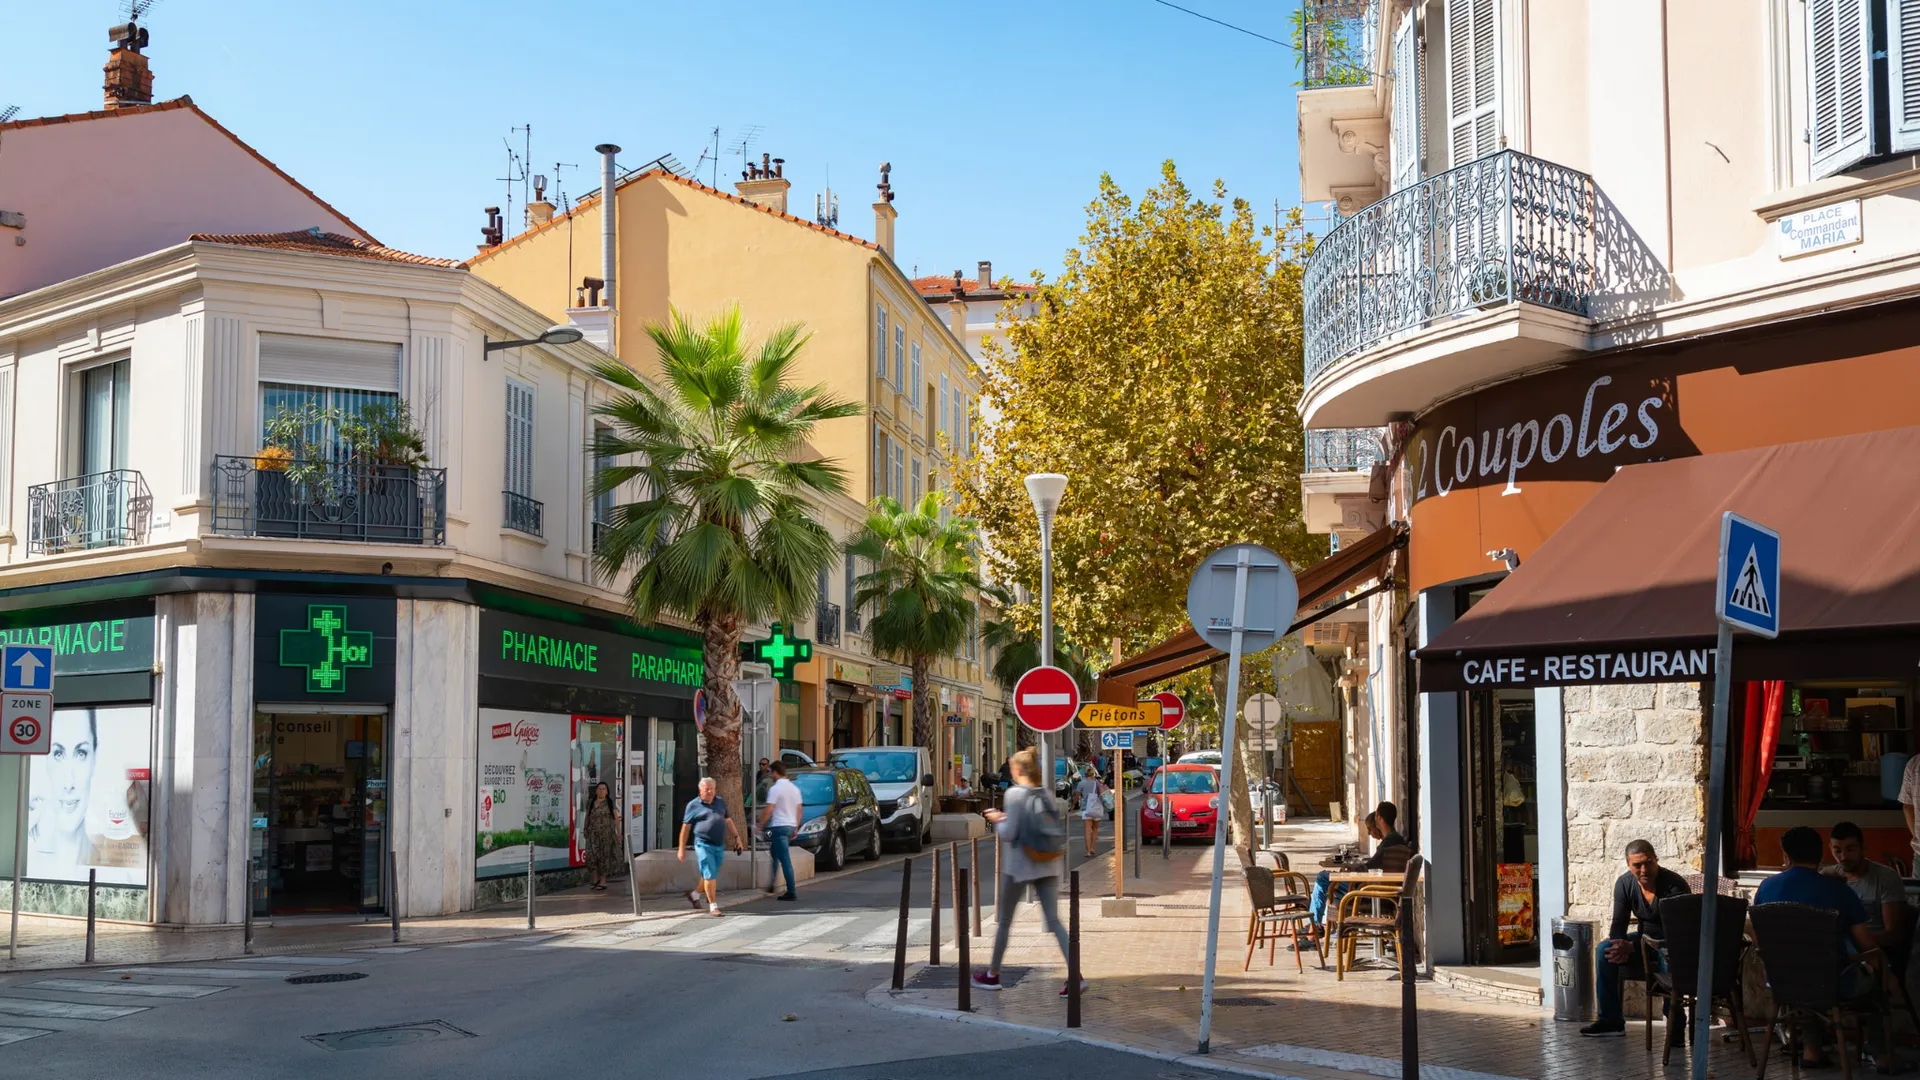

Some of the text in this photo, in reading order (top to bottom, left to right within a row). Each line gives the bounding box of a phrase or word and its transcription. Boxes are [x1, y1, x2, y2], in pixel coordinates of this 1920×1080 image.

[1803, 206, 1842, 224] PLACE
[1790, 216, 1858, 240] Commandant
[1800, 229, 1846, 249] MARIA
[1416, 439, 1428, 500] 2
[1434, 375, 1663, 497] Coupoles
[503, 630, 598, 673] PHARMACIE
[1463, 657, 1526, 684] CAFE
[1544, 649, 1718, 681] RESTAURANT
[12, 699, 42, 709] ZONE
[946, 714, 962, 723] Ria
[1089, 708, 1146, 722] Piétons
[16, 723, 36, 738] 30
[276, 720, 332, 734] conseil
